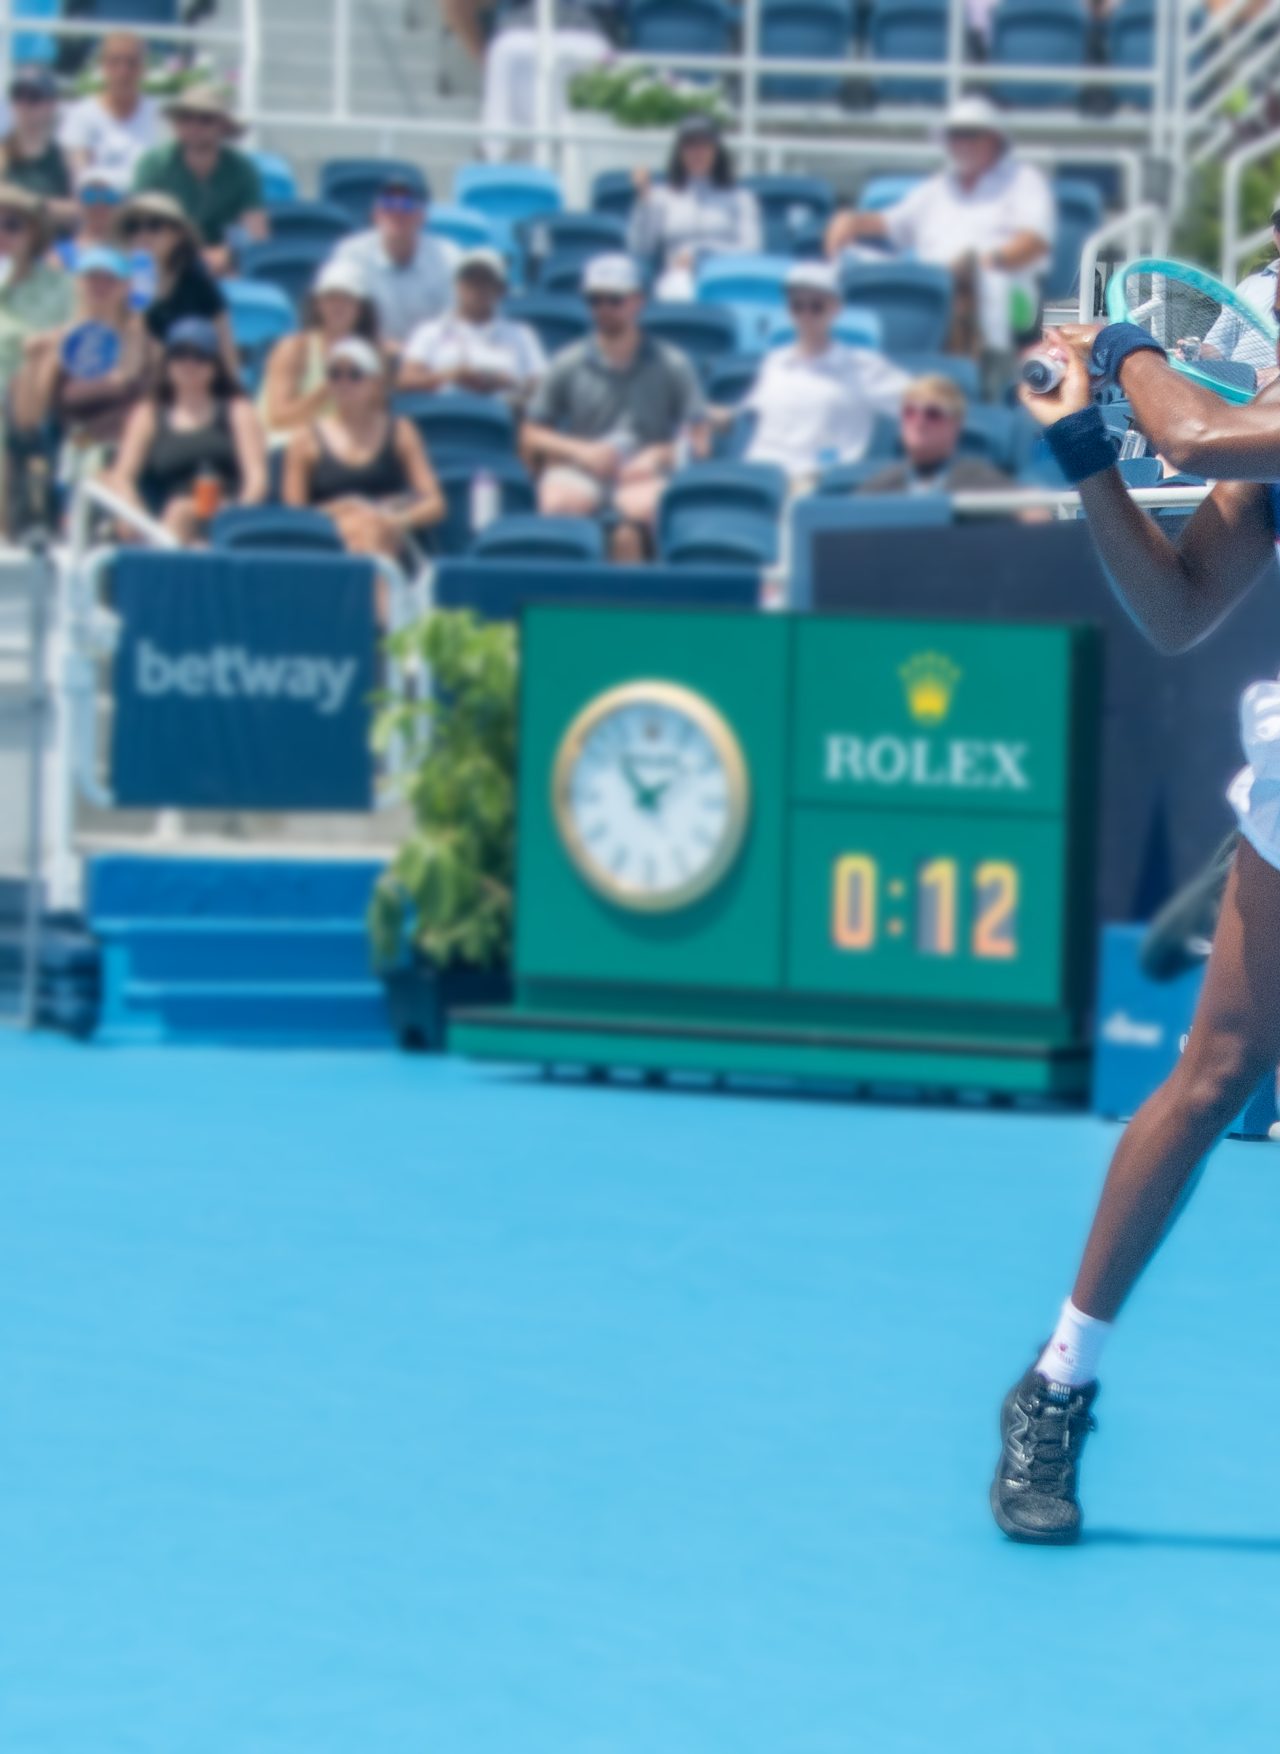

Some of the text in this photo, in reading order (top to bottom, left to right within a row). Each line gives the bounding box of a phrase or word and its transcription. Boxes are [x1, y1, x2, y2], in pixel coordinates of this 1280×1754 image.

[136, 641, 357, 714] betway
[825, 735, 1028, 788] ROLEX
[834, 853, 1018, 957] 0:12
